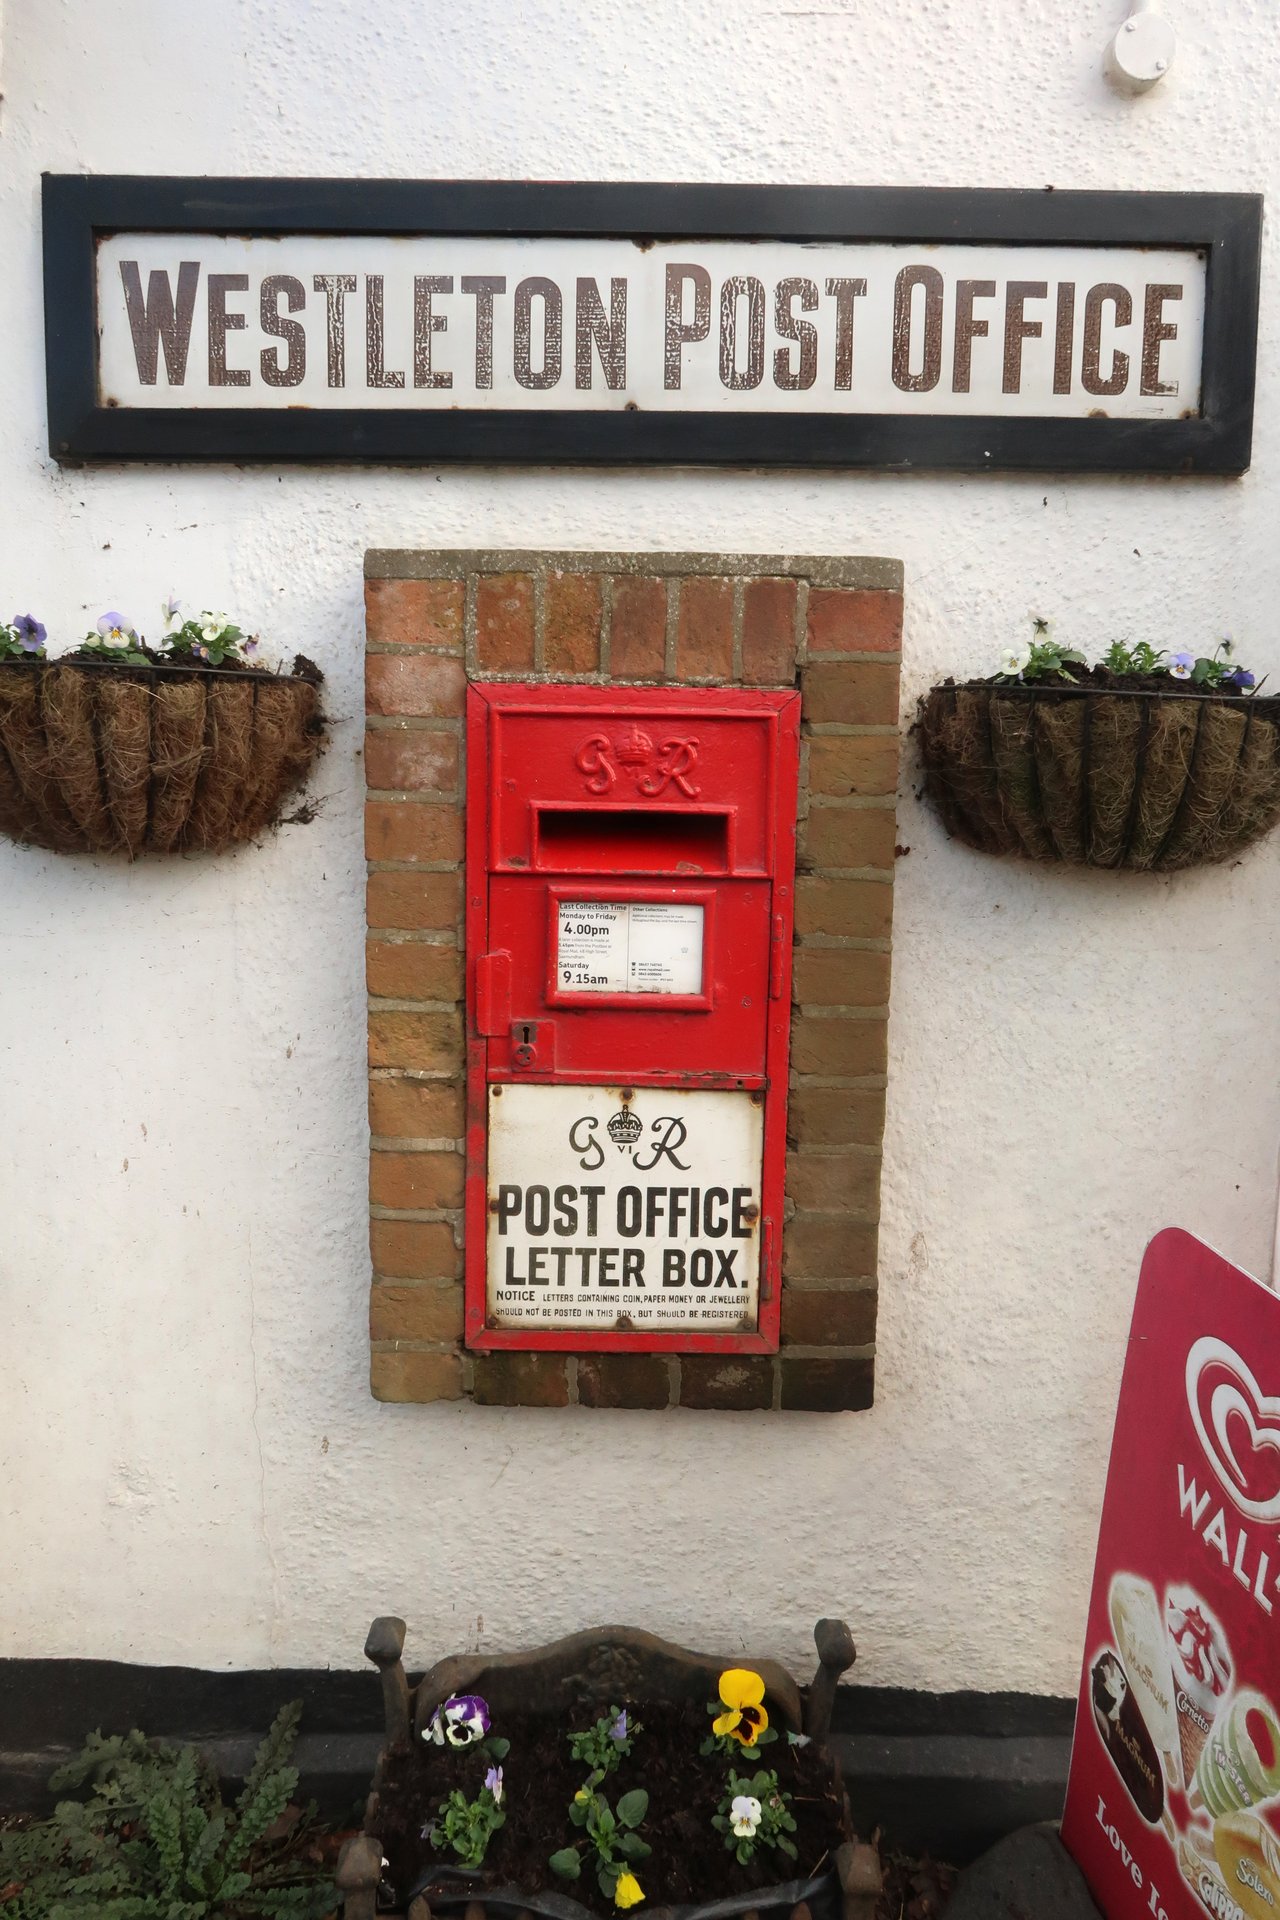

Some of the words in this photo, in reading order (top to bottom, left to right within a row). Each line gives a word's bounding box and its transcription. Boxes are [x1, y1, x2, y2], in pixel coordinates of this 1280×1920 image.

[119, 261, 628, 390] WESTLETON
[664, 263, 867, 391] POST
[891, 264, 1183, 397] OFFICE
[564, 922, 609, 937] 4.00pm
[559, 962, 589, 970] Saturday
[563, 971, 608, 984] 9.15am
[632, 1116, 692, 1170] R
[498, 1184, 605, 1236] POST
[616, 1186, 753, 1238] OFFICE
[505, 1246, 646, 1287] LETTER
[662, 1248, 749, 1288] BOX.
[496, 1291, 535, 1301] NOTICE
[543, 1293, 574, 1302] LETTERS
[577, 1294, 620, 1303] CONTAINING
[668, 1295, 693, 1304] MONEY
[696, 1295, 706, 1304] OR
[709, 1295, 751, 1304] JEWELLERY
[496, 1307, 523, 1316] SHOULD
[526, 1308, 540, 1316] NOT
[542, 1308, 552, 1317] BE
[554, 1308, 582, 1317] POSTED
[585, 1309, 594, 1317] IN
[596, 1309, 613, 1317] THIS
[638, 1309, 653, 1318] BUT
[656, 1309, 686, 1318] SHOULD
[689, 1310, 698, 1318] BE
[701, 1310, 749, 1319] REGISTERED
[1127, 1652, 1169, 1714] MAGNUM
[1176, 1691, 1210, 1734] Cornetto
[1115, 1721, 1156, 1788] MAGNUM
[1095, 1794, 1143, 1888] Love
